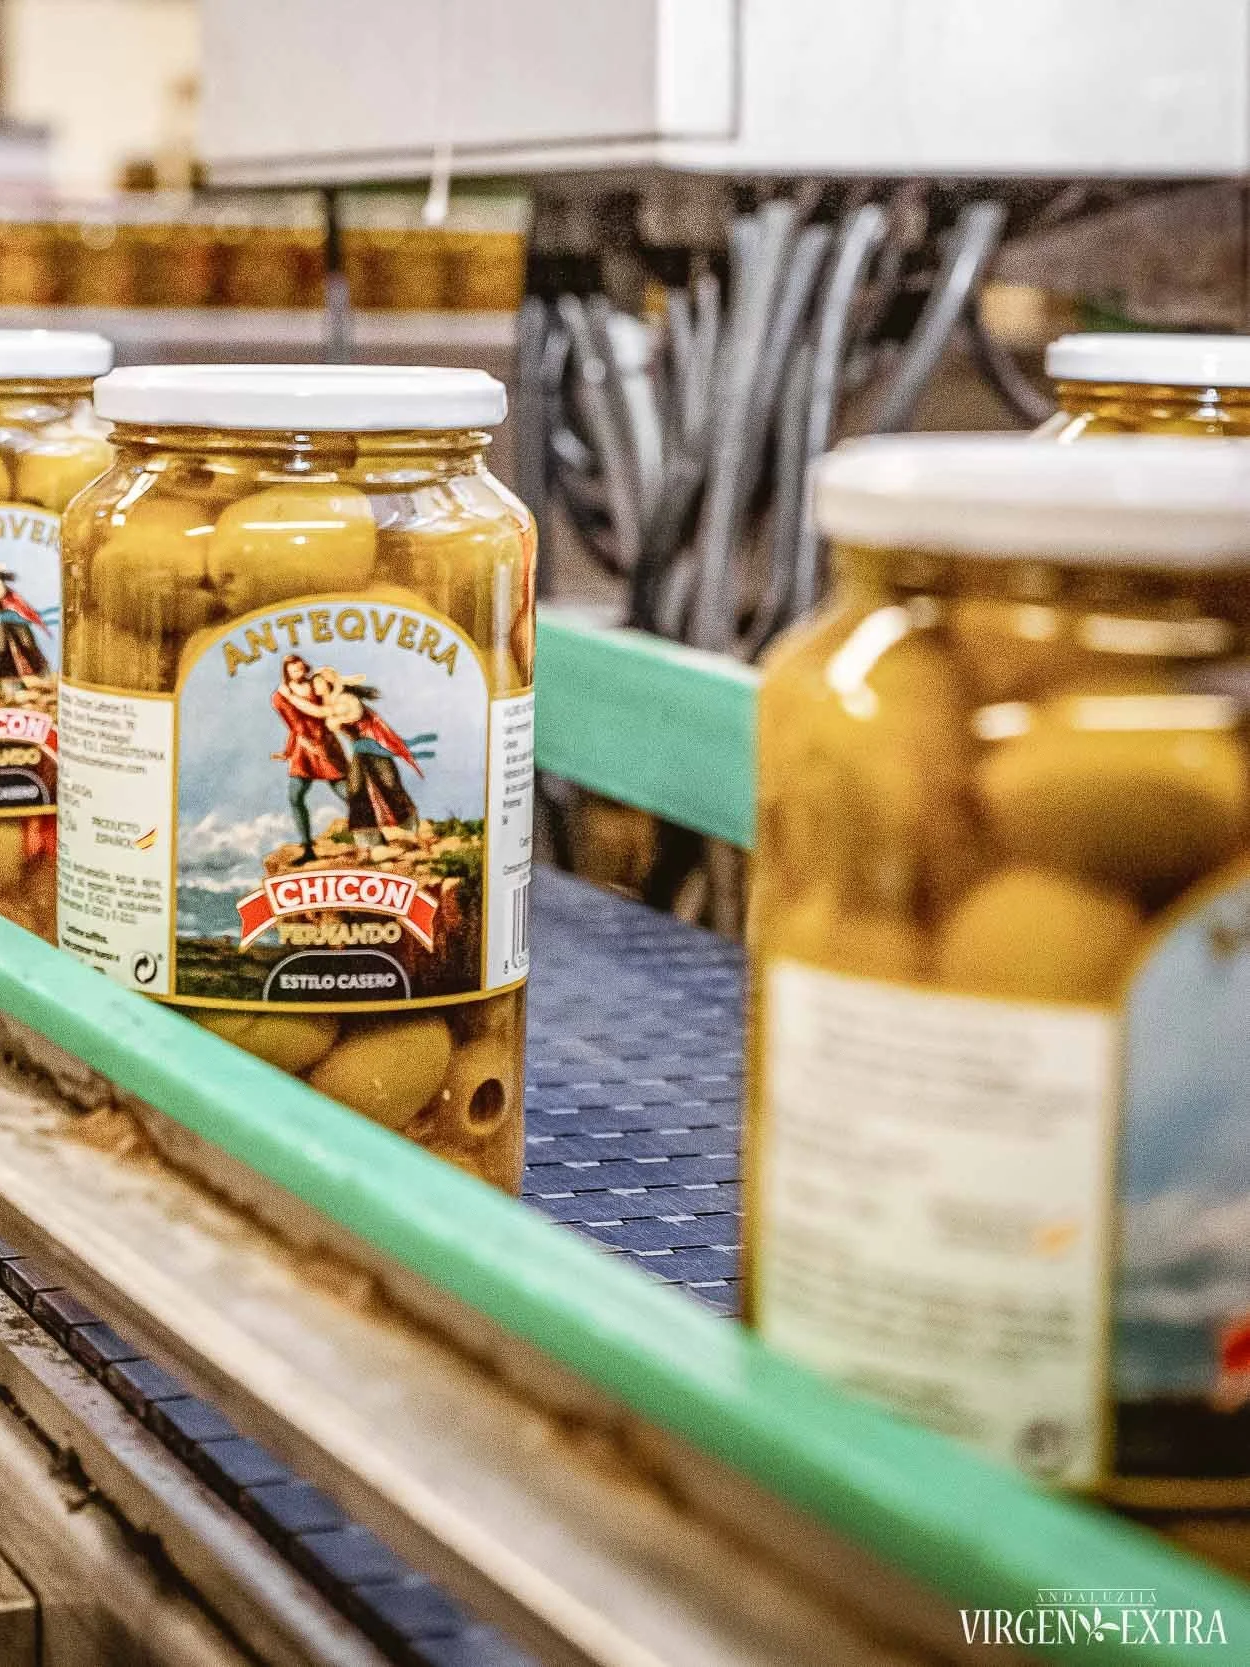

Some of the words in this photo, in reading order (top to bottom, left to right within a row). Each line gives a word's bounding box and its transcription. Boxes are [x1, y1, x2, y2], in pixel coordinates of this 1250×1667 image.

[222, 608, 461, 677] ANTEQVERA
[279, 974, 336, 990] ESTILO
[336, 973, 398, 990] CASERO
